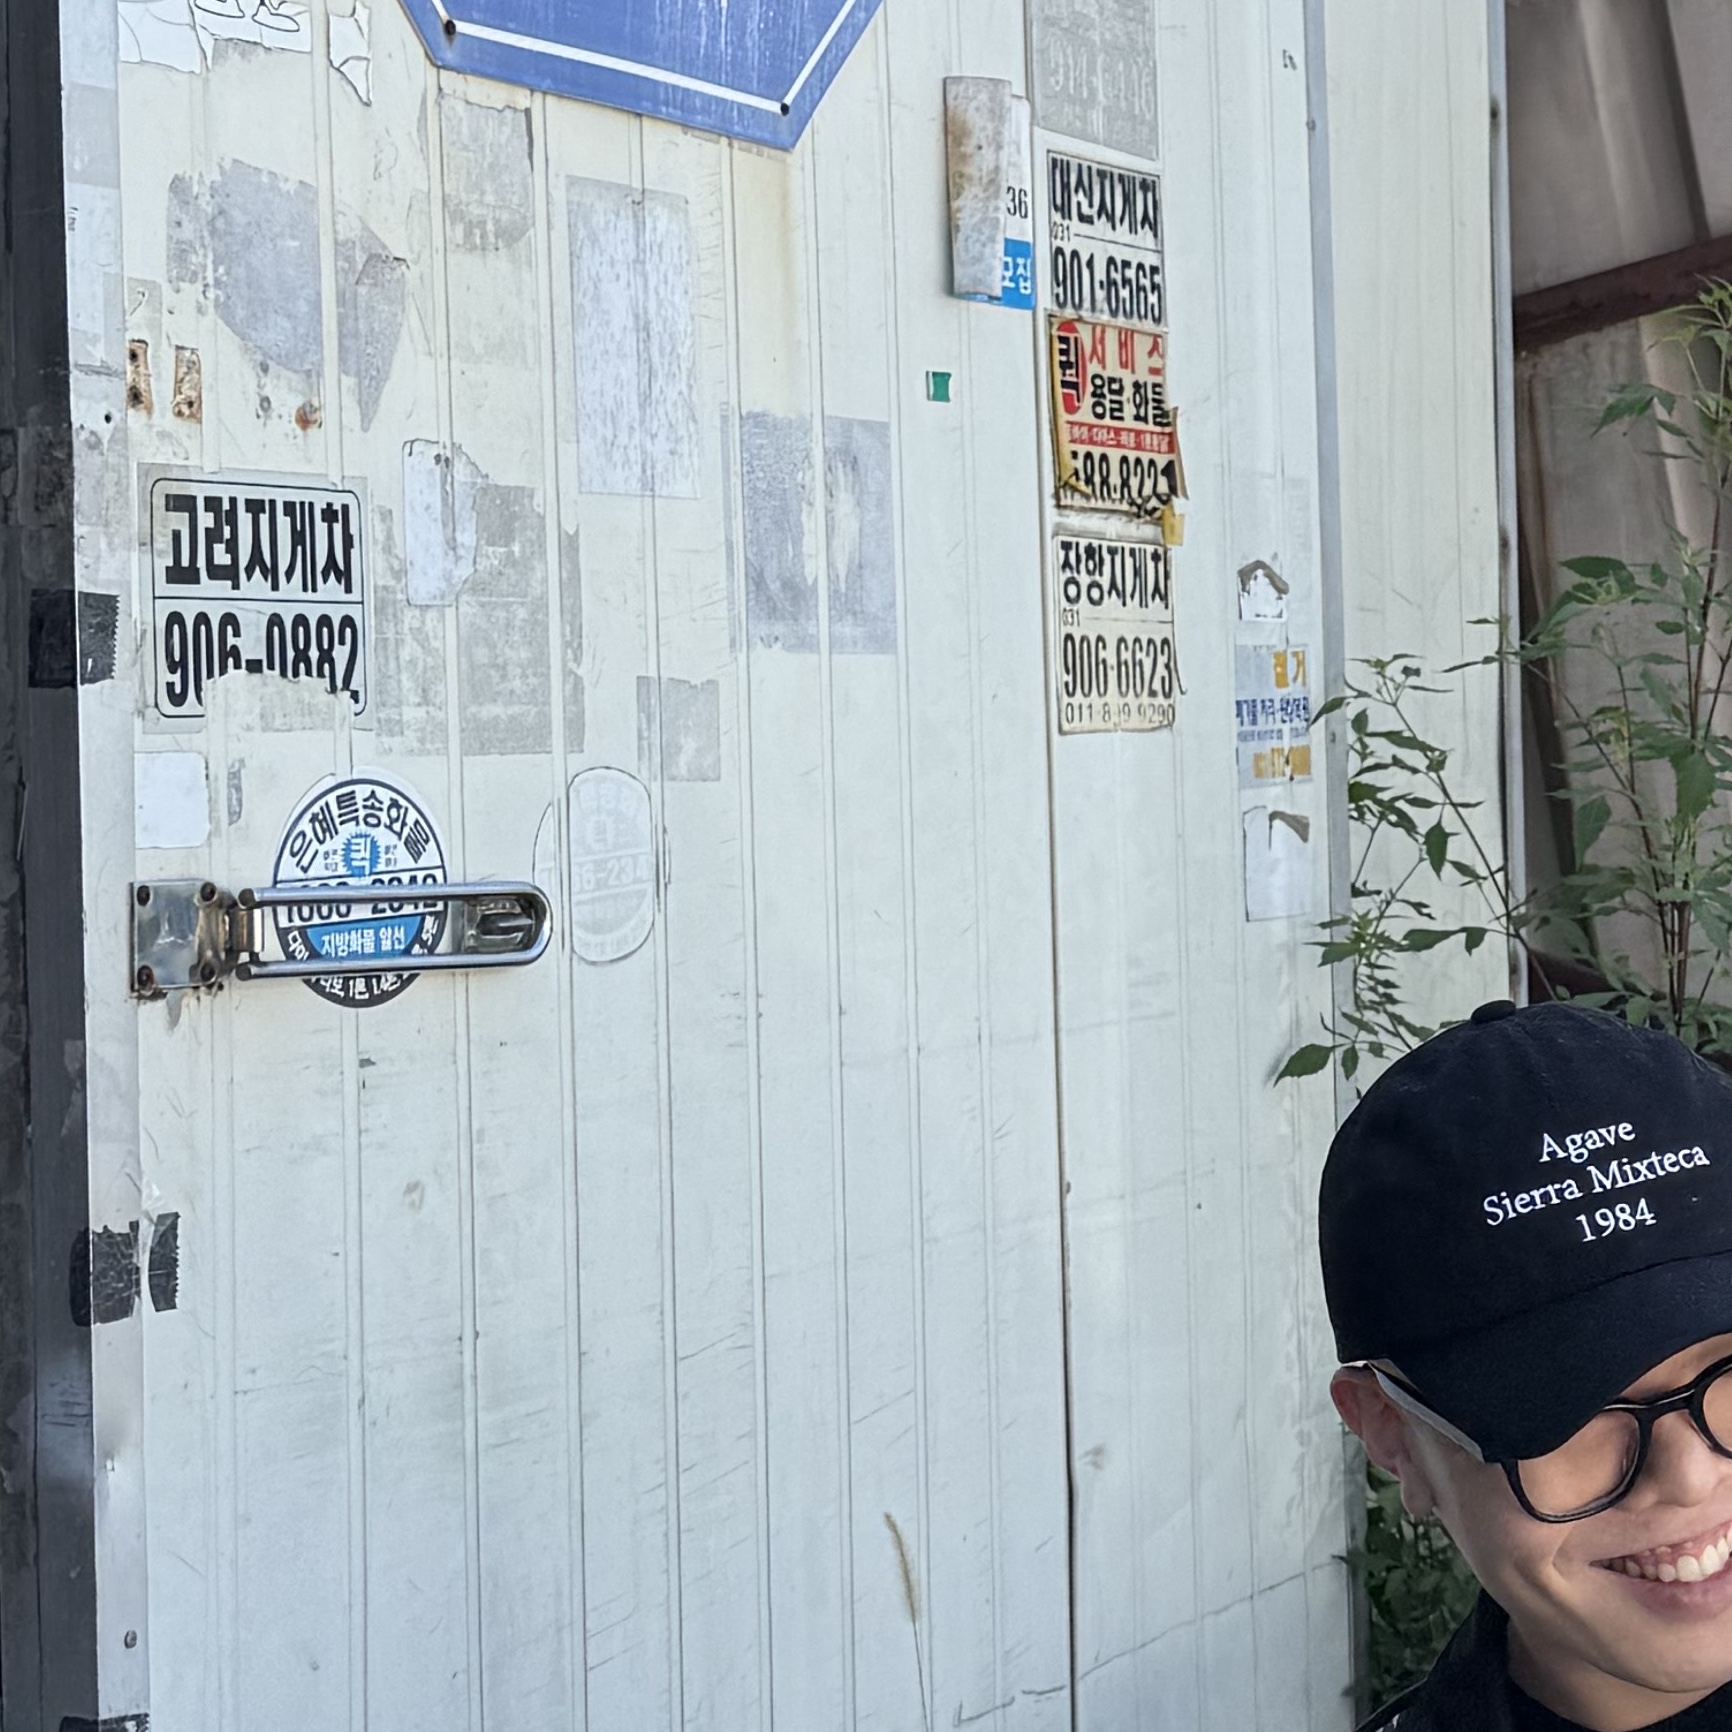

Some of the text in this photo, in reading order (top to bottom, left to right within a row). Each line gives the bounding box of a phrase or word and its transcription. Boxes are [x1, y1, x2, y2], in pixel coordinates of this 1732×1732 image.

[1051, 156, 1159, 240] 대신지게차
[1001, 256, 1032, 295] 모집
[1057, 335, 1082, 405] 퀵
[164, 493, 355, 594] 고려지게차
[1060, 540, 1171, 610] 장항지게차
[164, 610, 360, 708] 906-0882
[1538, 1121, 1636, 1163] Agave
[1482, 1144, 1712, 1226] Sierra Mixteca
[1574, 1197, 1658, 1243] 1984
